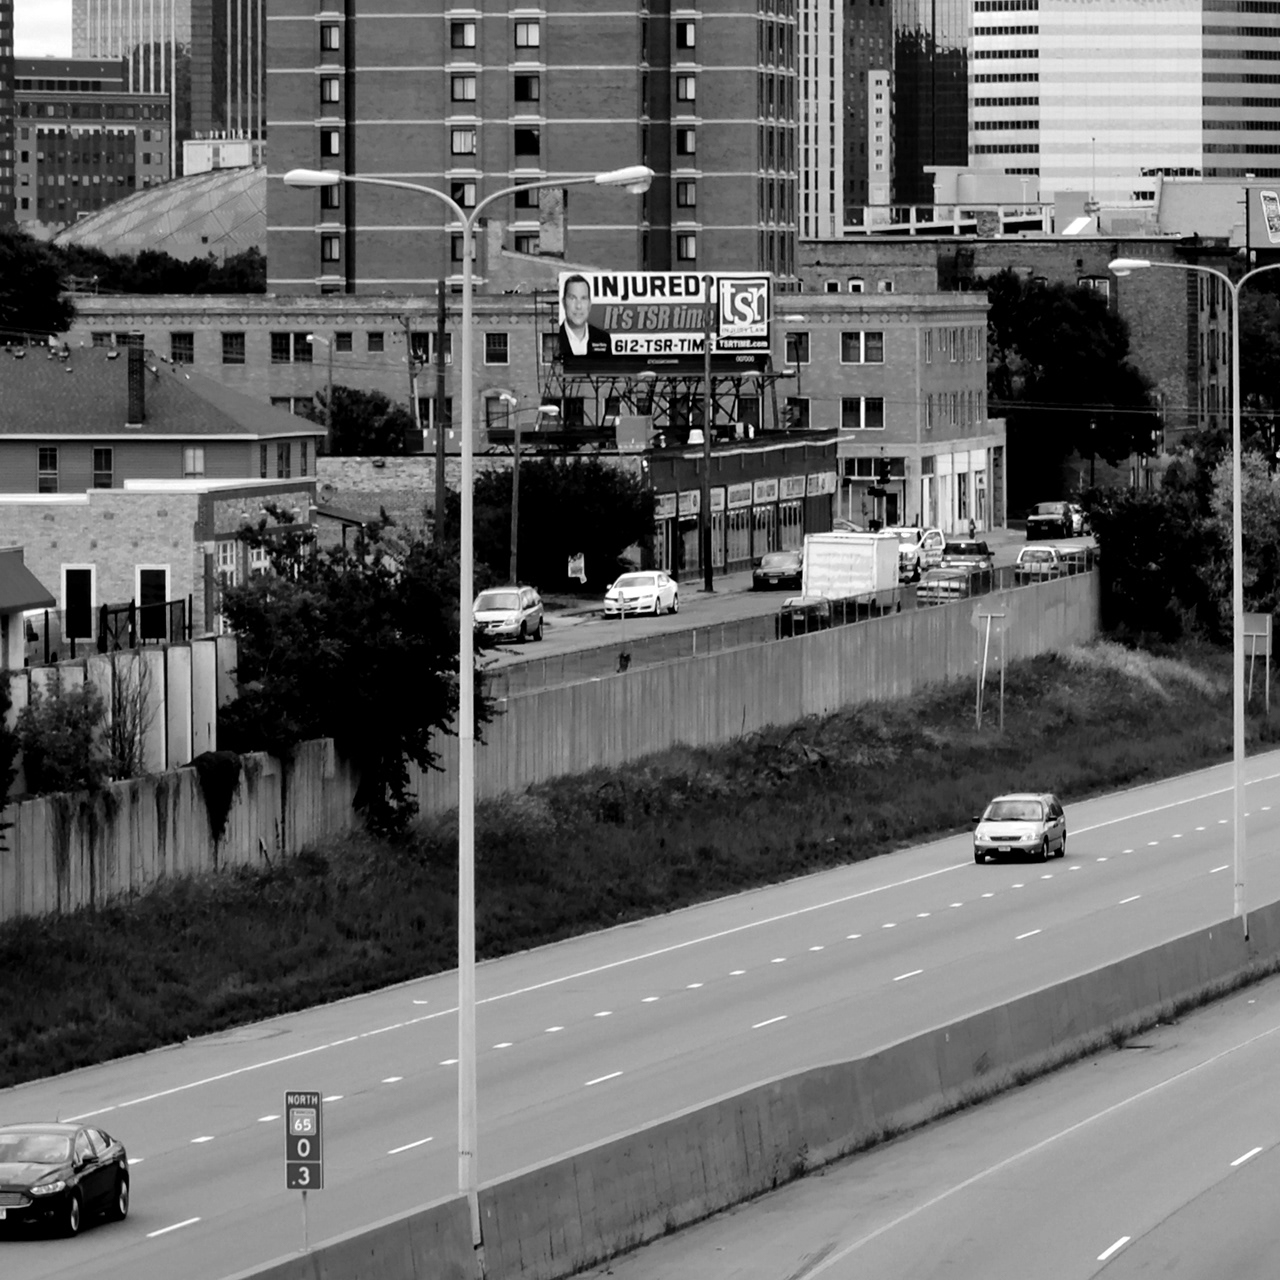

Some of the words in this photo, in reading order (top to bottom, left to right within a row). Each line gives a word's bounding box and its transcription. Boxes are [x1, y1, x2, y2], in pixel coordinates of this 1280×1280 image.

[721, 279, 766, 325] tsr
[603, 305, 634, 330] It's
[636, 305, 669, 329] TSR
[287, 1094, 318, 1105] NORTH
[294, 1118, 312, 1132] 65
[297, 1138, 311, 1158] 0
[292, 1166, 310, 1186] .3
